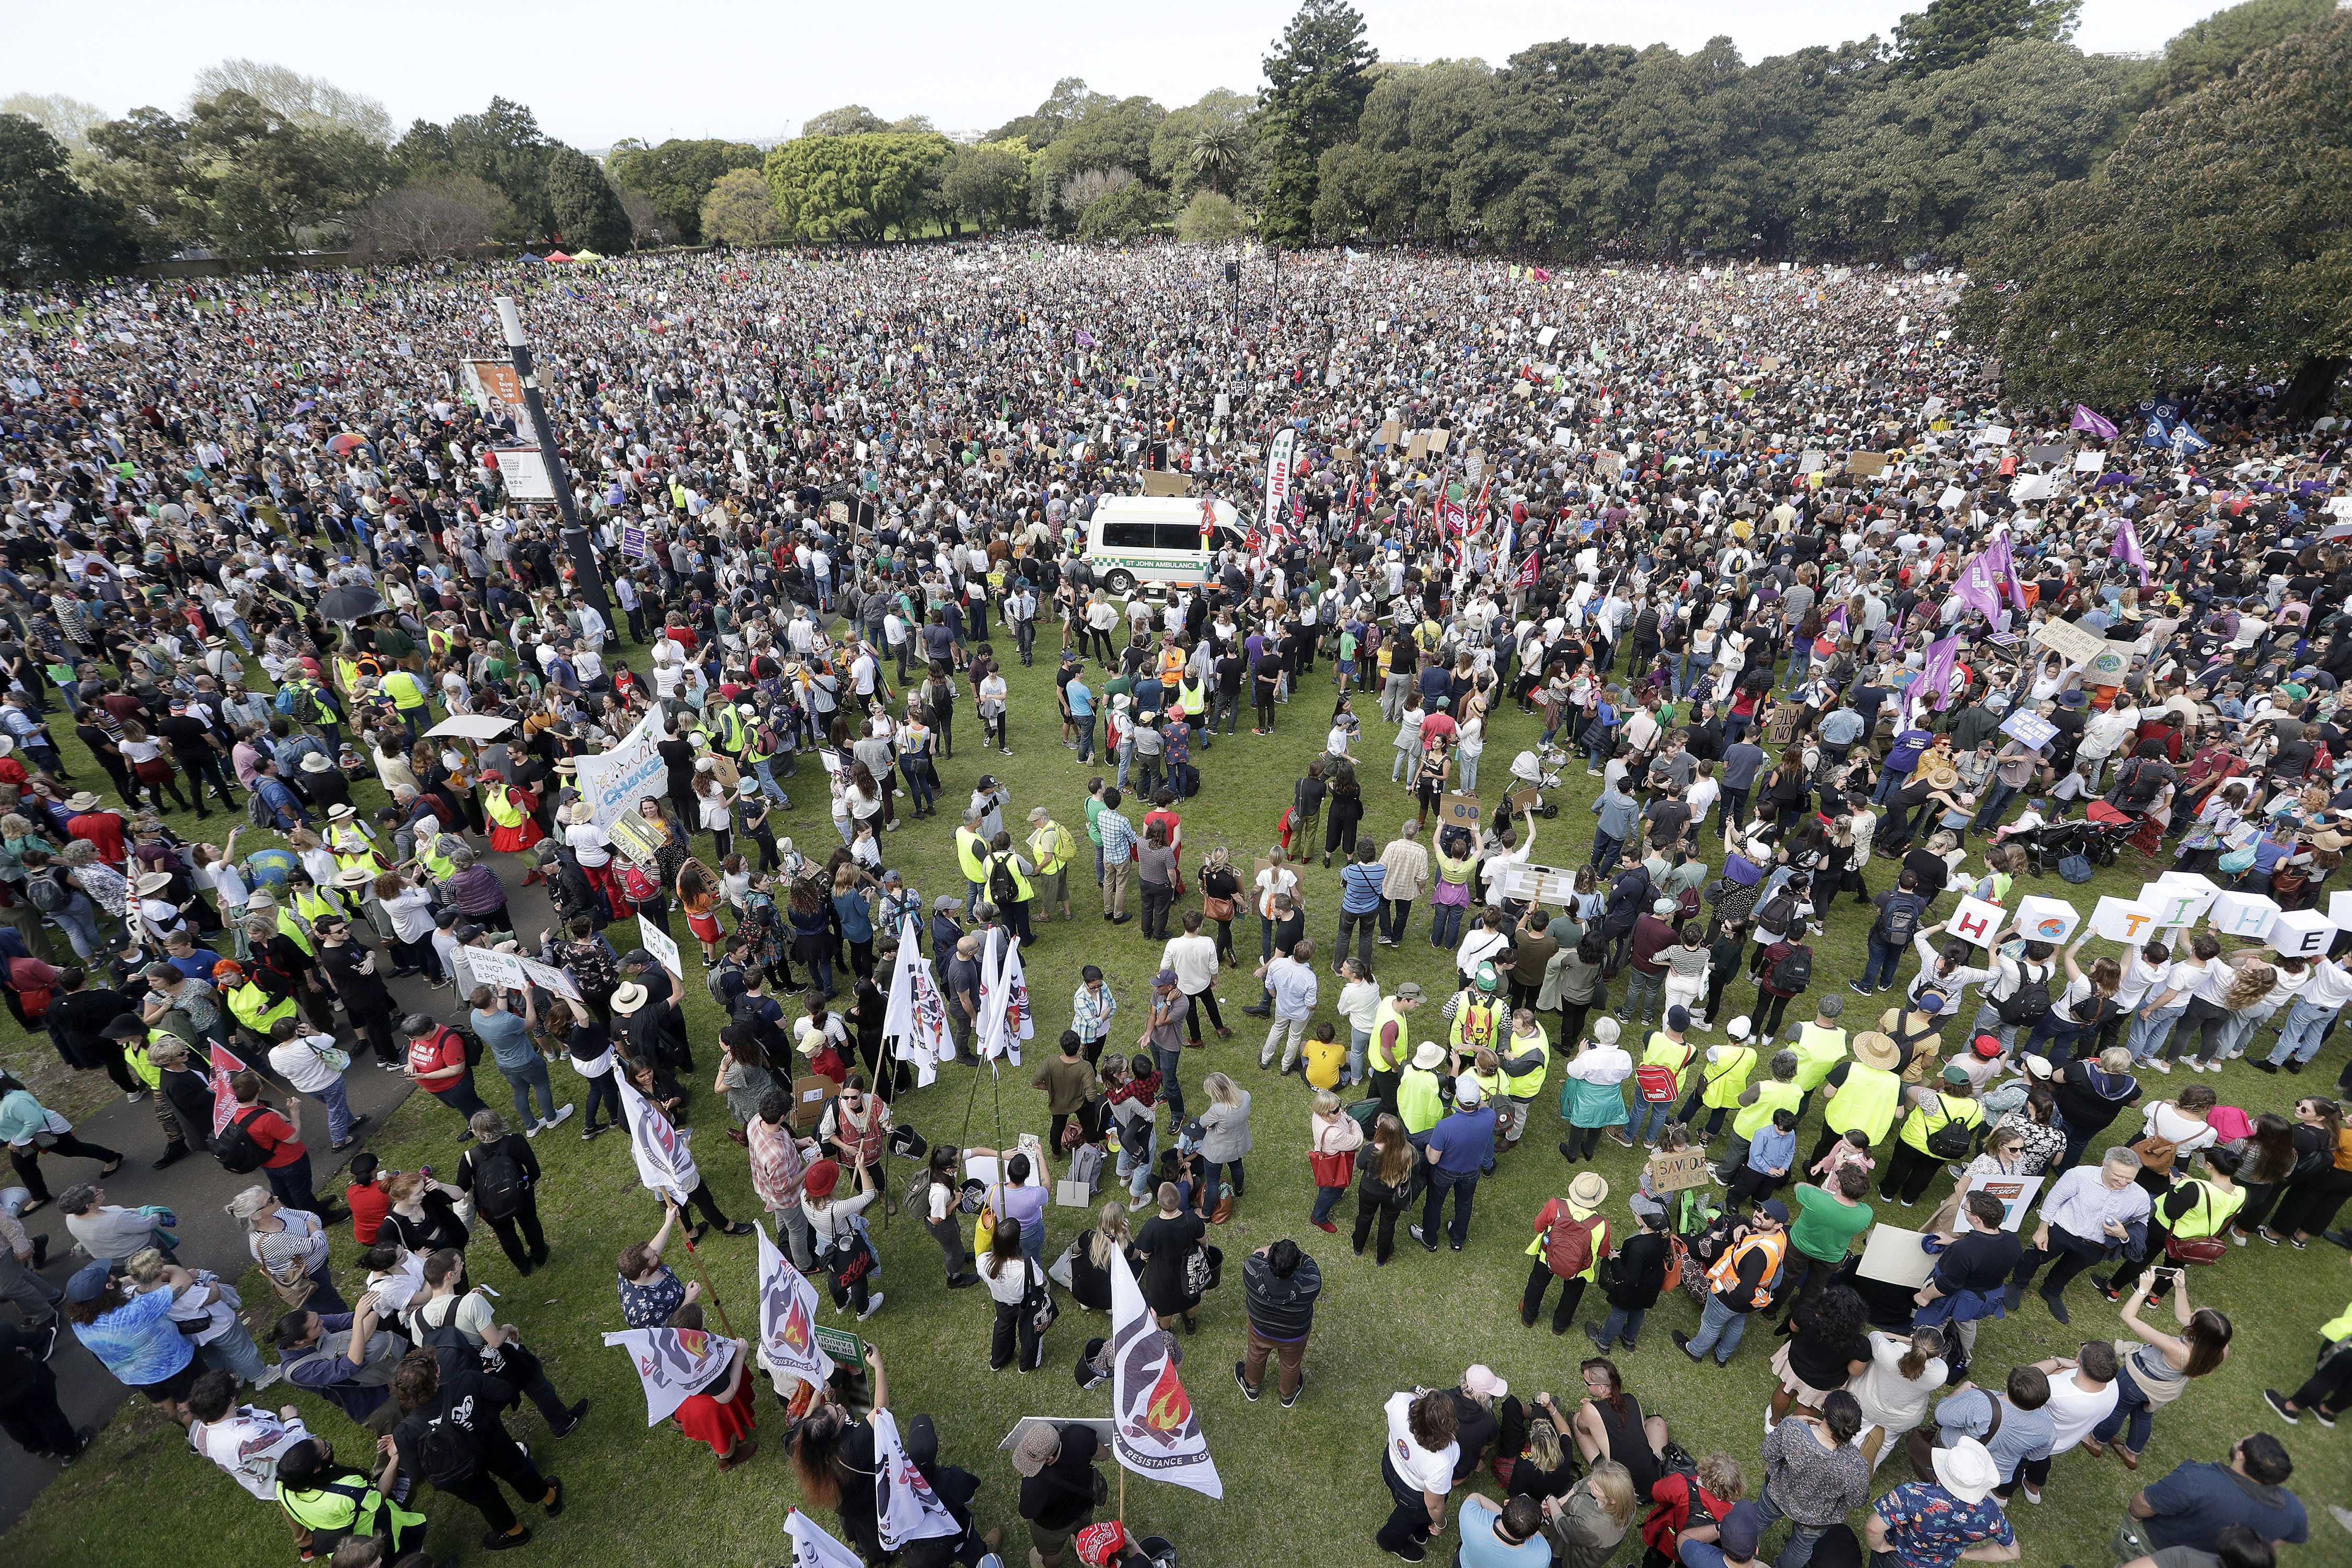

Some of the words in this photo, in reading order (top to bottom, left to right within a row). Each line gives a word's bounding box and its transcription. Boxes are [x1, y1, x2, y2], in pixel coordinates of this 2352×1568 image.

[2186, 435, 2208, 450] RTBU
[1272, 463, 1286, 497] John
[2043, 627, 2058, 638] CARE
[2059, 633, 2076, 647] ABOUT
[2081, 643, 2094, 655] YOUR
[2051, 621, 2073, 639] SCIENCE
[2076, 633, 2098, 649] DOESN'T
[2010, 716, 2022, 727] THE
[2021, 721, 2048, 741] GALILEE
[2013, 727, 2034, 741] BASIN
[2018, 711, 2035, 724] DON'T
[2035, 720, 2054, 734] MINE
[603, 754, 664, 806] CHANGE
[610, 789, 640, 817] action
[623, 818, 635, 829] GLOBAL
[632, 827, 646, 839] CLIMATE
[643, 836, 654, 846] STRIKE
[2139, 827, 2156, 843] OUR
[2133, 836, 2157, 854] UTURE
[643, 923, 661, 944] ACT
[1958, 912, 1988, 939] H
[2126, 914, 2151, 937] T
[2234, 907, 2268, 934] H
[2299, 931, 2324, 951] E
[469, 952, 504, 964] DENIAL
[646, 936, 667, 961] NOW
[485, 974, 516, 986] POLICY
[486, 965, 503, 974] NOT
[523, 961, 549, 975] THERE
[644, 1147, 667, 1170] FIGHTING
[1659, 1159, 1688, 1176] SAVE
[1690, 1157, 1707, 1171] OUR
[819, 1337, 852, 1348] FARUQI
[701, 1346, 723, 1382] RESISTANCE
[760, 1345, 767, 1357] IN
[770, 1355, 813, 1371] RESISTANCE
[1114, 1432, 1123, 1444] IN
[1125, 1449, 1183, 1468] RESISTANCE
